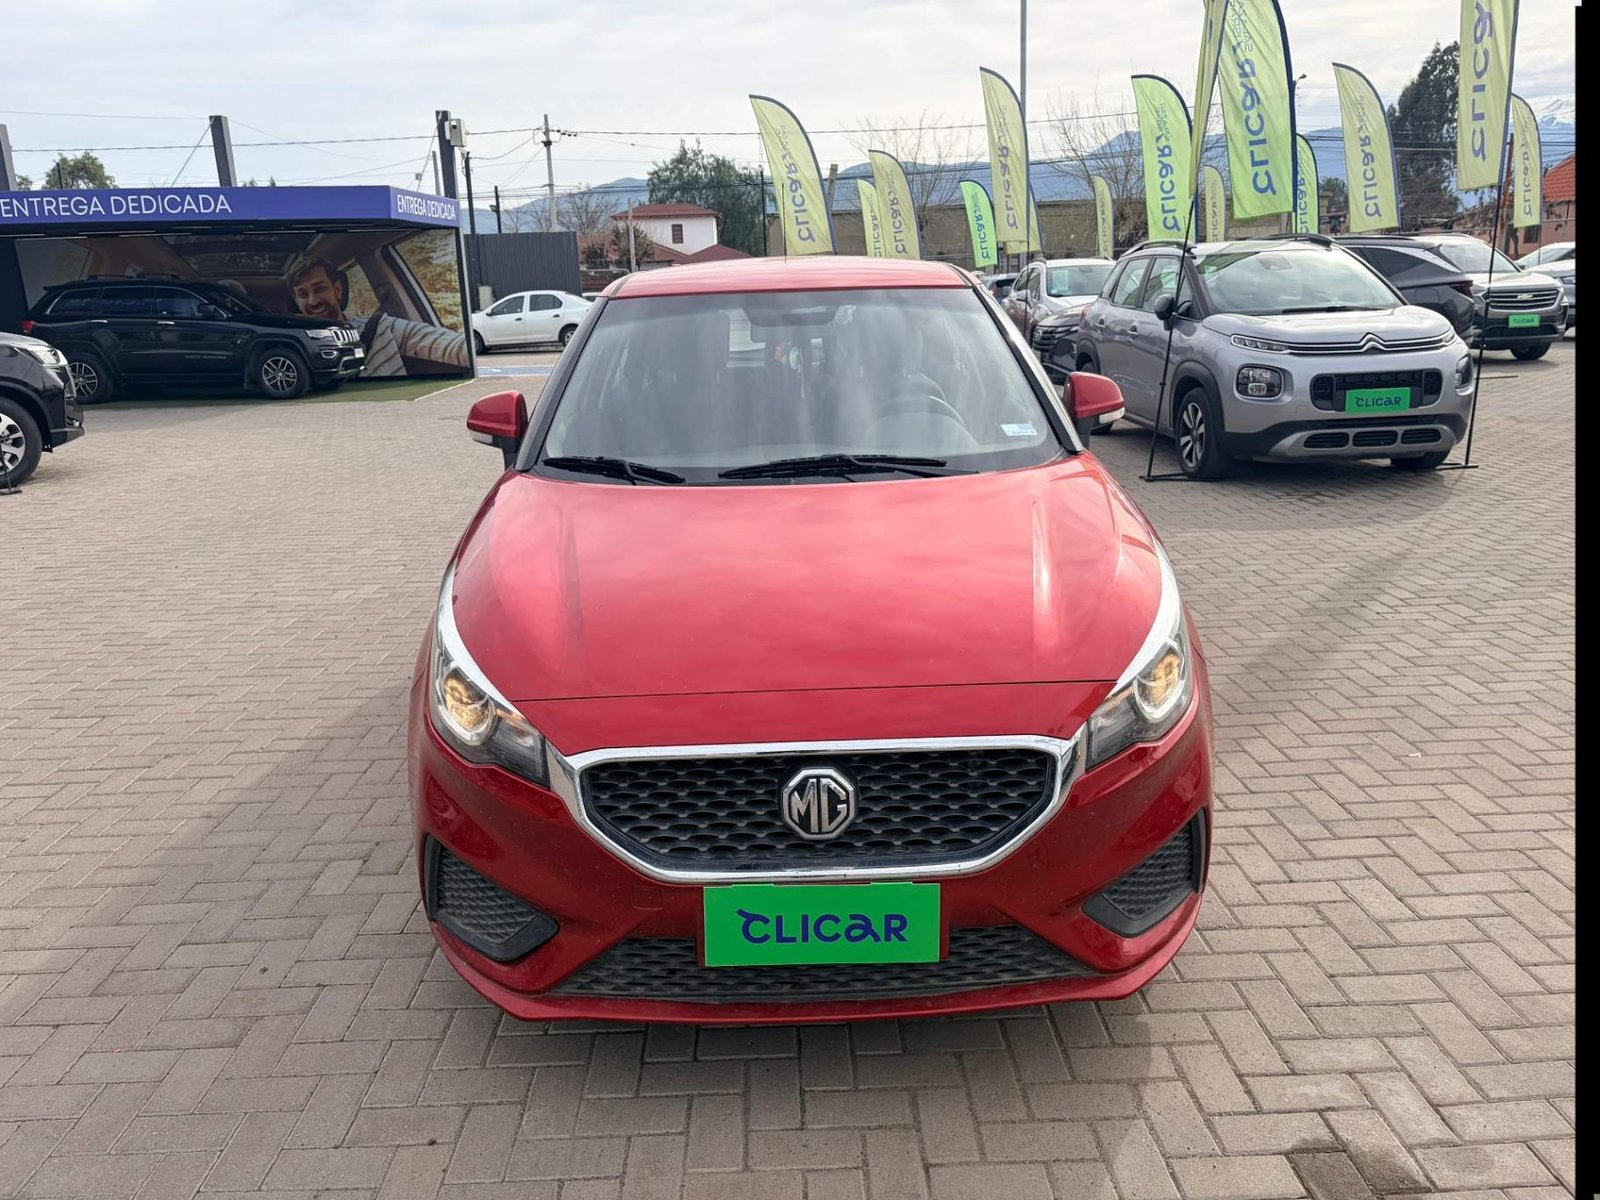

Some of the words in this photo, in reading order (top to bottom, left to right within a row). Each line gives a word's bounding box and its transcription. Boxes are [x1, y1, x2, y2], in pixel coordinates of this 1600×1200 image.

[0, 196, 105, 217] ENTREGA
[110, 194, 232, 215] DEDICADA
[397, 194, 427, 216] ENTREGA
[427, 199, 457, 221] DEDICADA
[791, 776, 848, 832] MG
